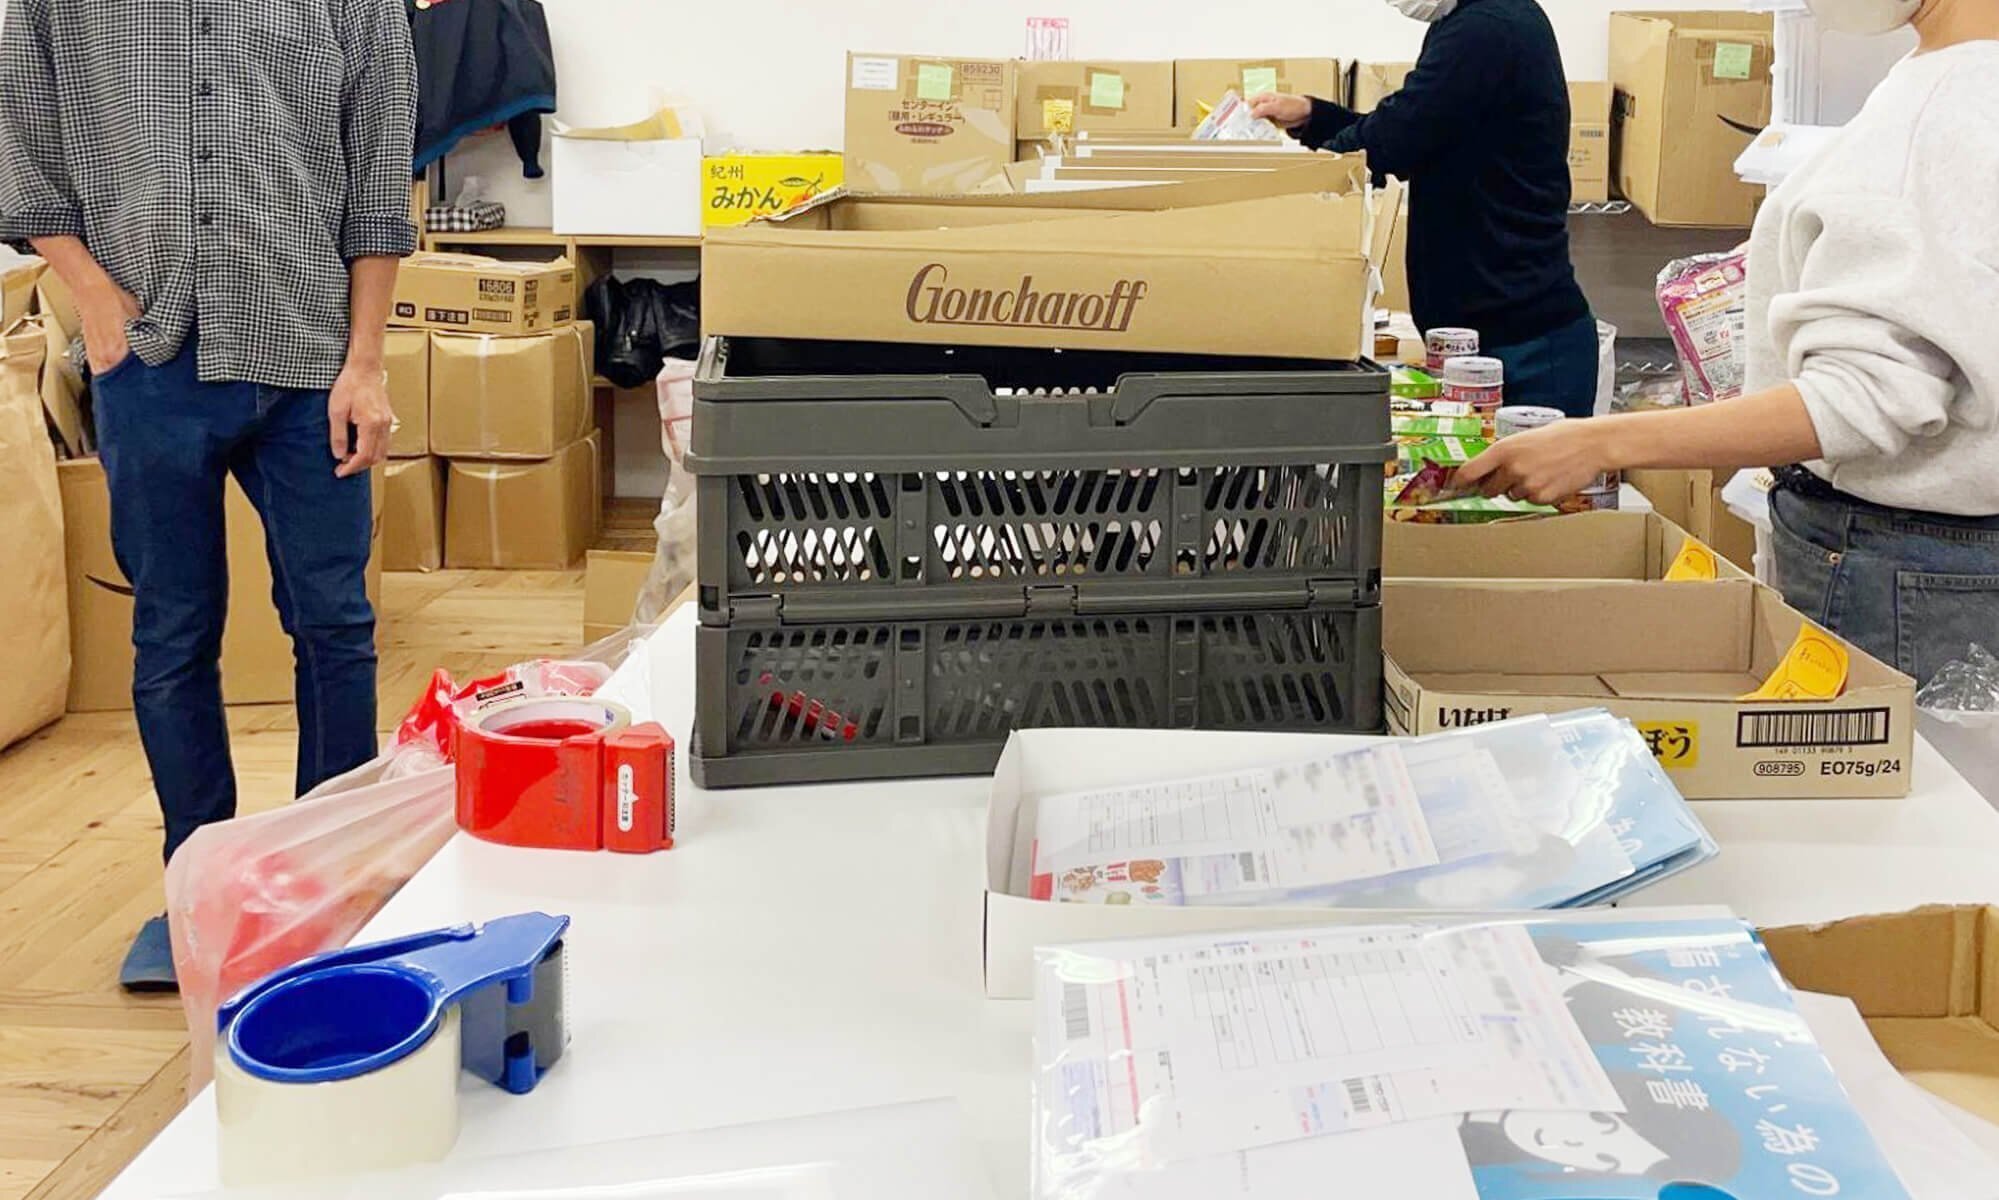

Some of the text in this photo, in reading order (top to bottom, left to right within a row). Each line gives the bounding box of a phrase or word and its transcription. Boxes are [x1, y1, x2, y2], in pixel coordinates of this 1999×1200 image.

[710, 164, 744, 180] 紀州
[711, 187, 783, 209] みかん
[906, 263, 1148, 332] Goncharoff
[1758, 763, 1801, 774] 908795
[1820, 759, 1901, 777] EO75g/24
[1612, 1006, 1711, 1112] 教科書
